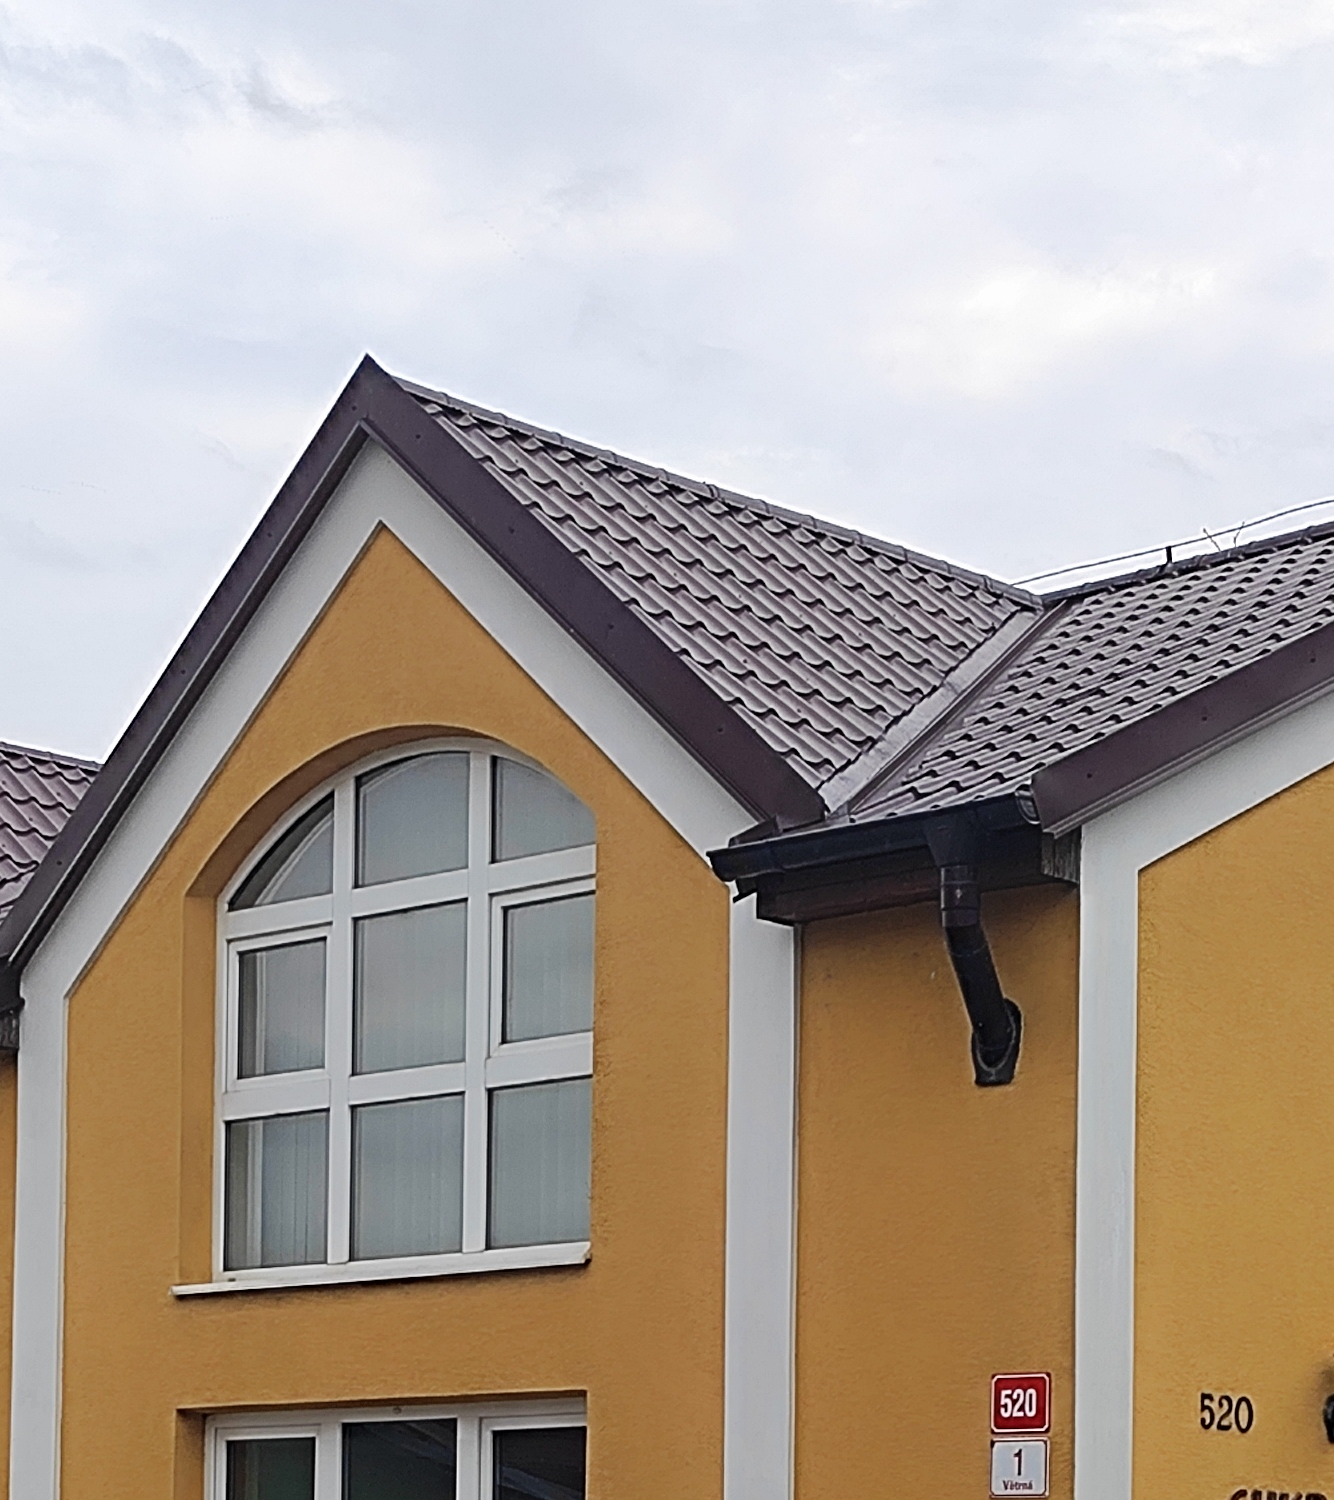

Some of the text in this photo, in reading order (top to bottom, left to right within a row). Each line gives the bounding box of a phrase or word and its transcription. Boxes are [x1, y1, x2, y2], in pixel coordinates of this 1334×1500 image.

[999, 1388, 1037, 1418] 520
[1199, 1393, 1255, 1434] 520
[1013, 1448, 1023, 1476] 1
[1002, 1479, 1033, 1491] Větrná
